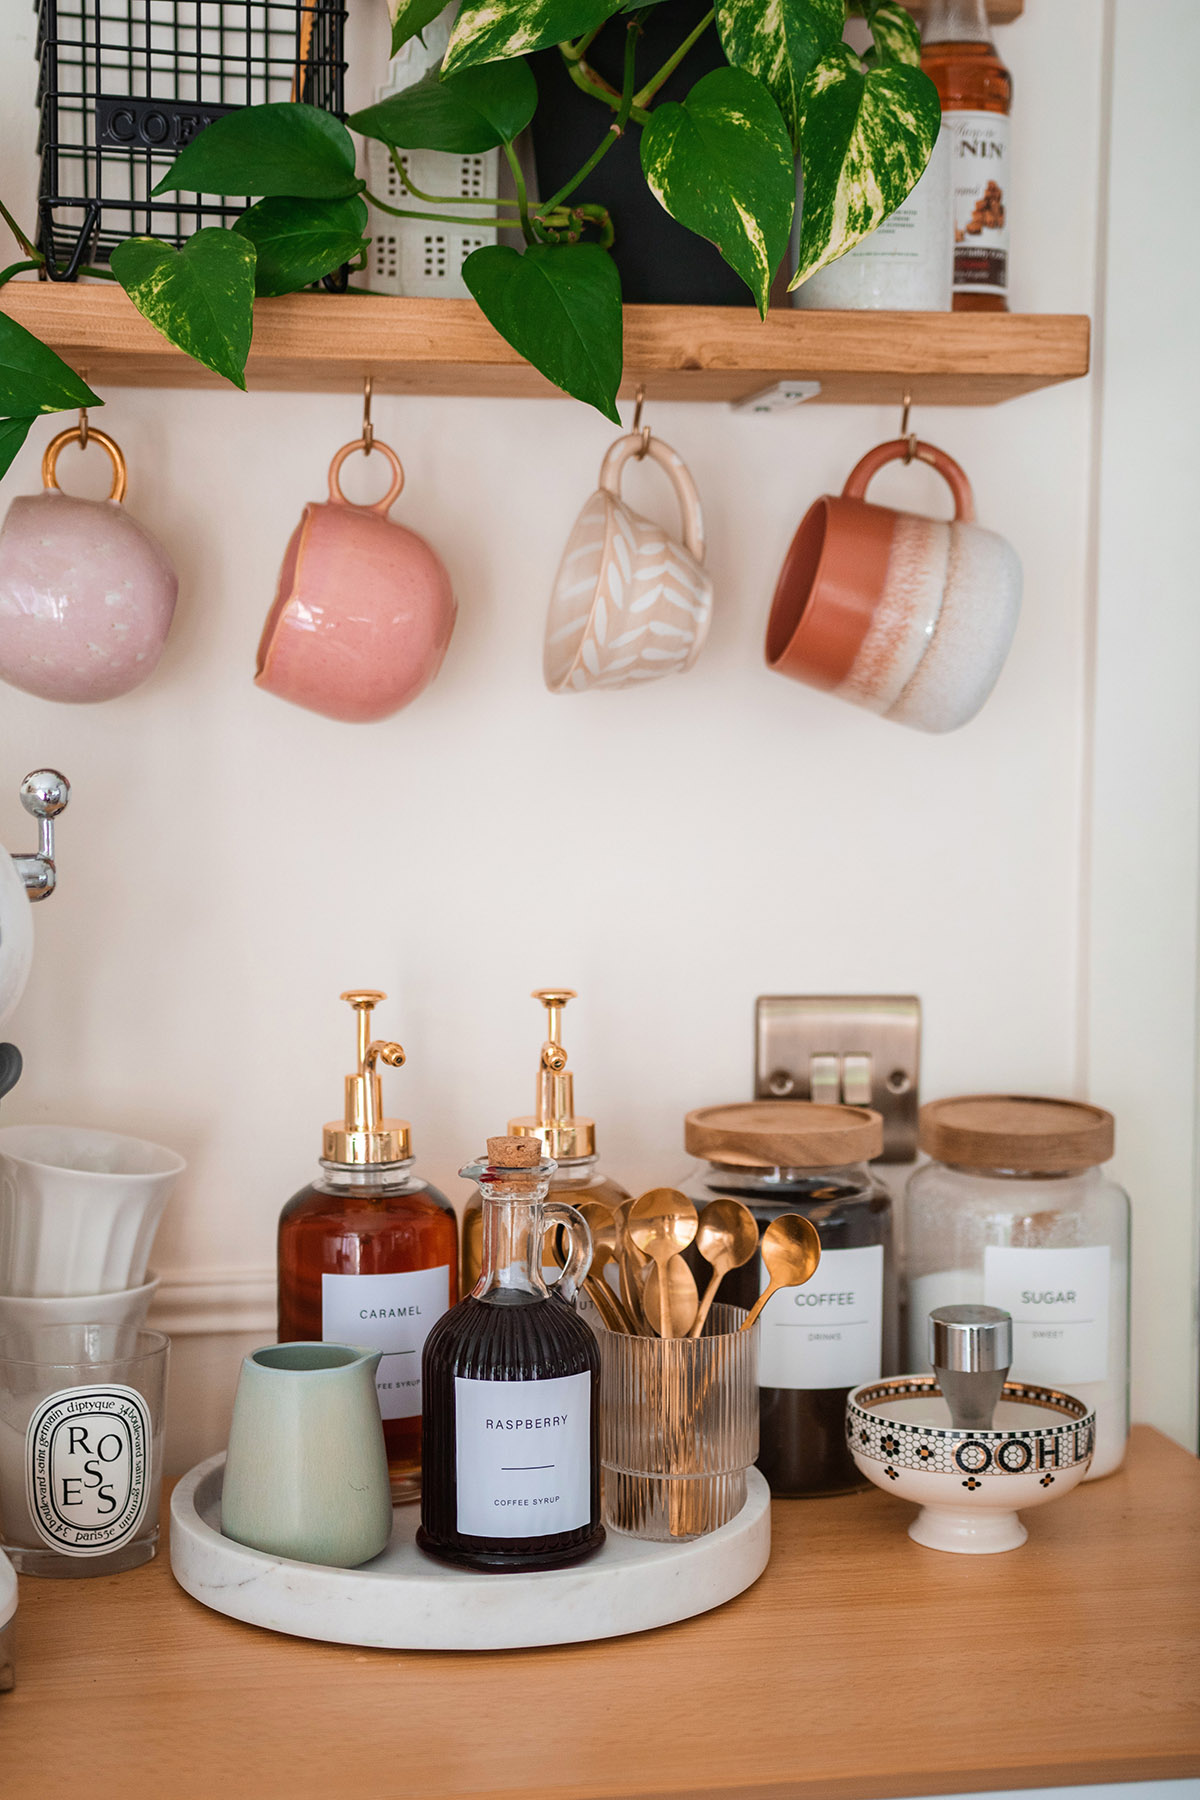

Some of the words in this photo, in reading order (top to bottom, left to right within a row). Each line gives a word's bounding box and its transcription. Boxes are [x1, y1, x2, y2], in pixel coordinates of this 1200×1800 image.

[955, 140, 1006, 158] NIN
[794, 1292, 855, 1307] COFFEE
[1021, 1291, 1077, 1304] SUGAR
[359, 1306, 422, 1319] CARAMEL
[377, 1382, 392, 1390] FEE
[396, 1380, 421, 1389] SYRUP
[67, 1400, 116, 1413] diptyque
[39, 1409, 63, 1448] germain
[486, 1414, 568, 1430] RASPBERRY
[36, 1449, 46, 1474] saint
[952, 1436, 1059, 1474] OOH
[119, 1487, 140, 1529] germain
[494, 1499, 529, 1507] COFFEE
[532, 1495, 560, 1506] SYRUP
